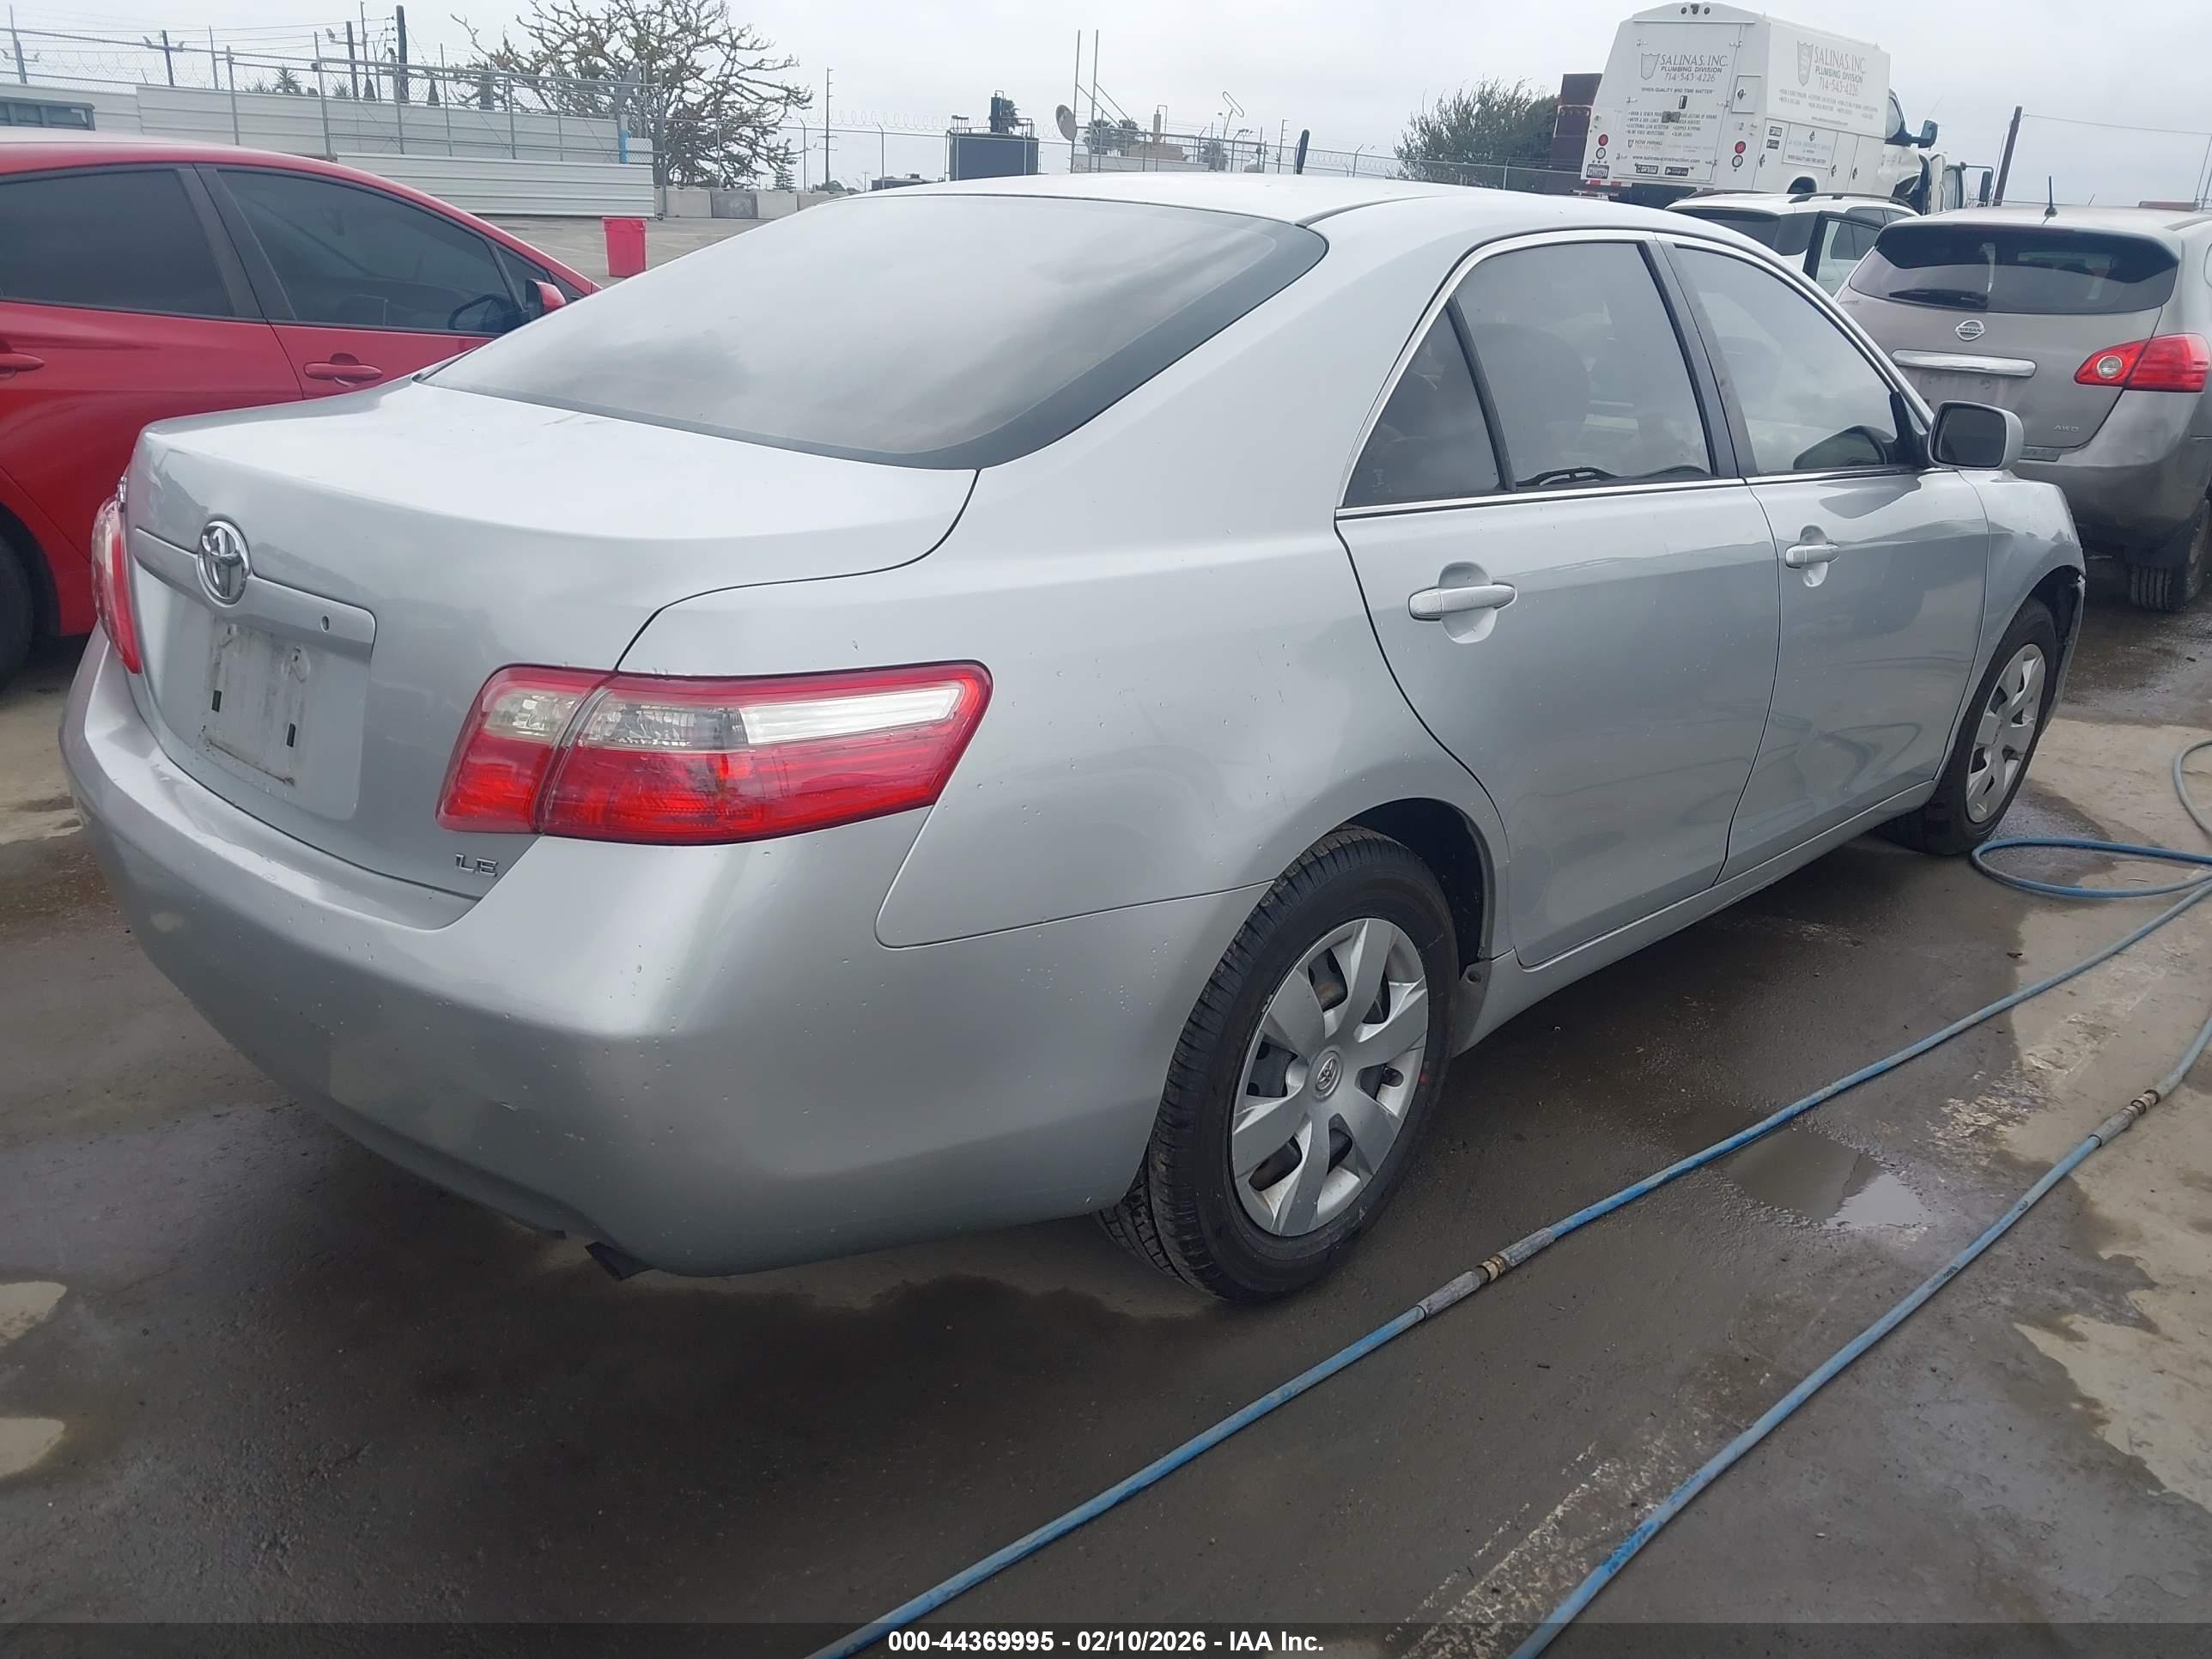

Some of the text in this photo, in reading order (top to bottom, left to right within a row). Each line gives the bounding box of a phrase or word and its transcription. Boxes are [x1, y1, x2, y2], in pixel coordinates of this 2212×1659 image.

[1815, 65, 1863, 83] PLUMBING DIVISION
[454, 853, 498, 878] LE
